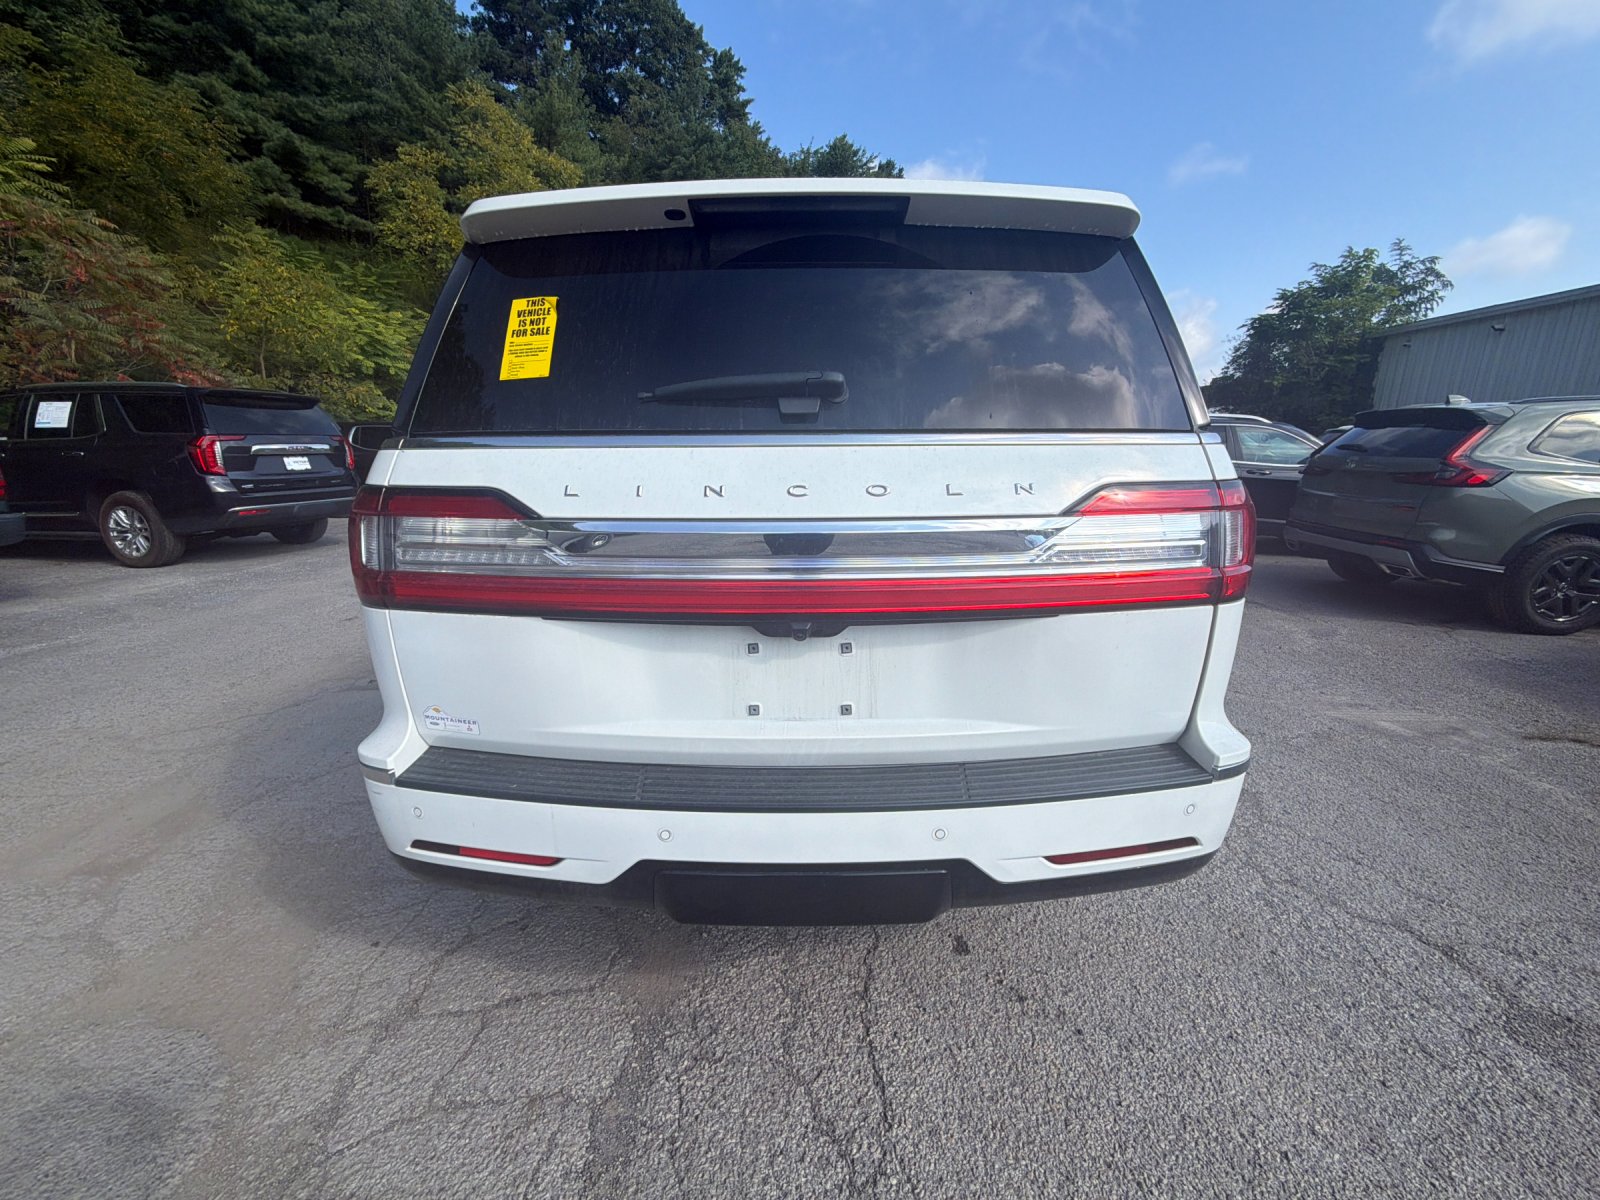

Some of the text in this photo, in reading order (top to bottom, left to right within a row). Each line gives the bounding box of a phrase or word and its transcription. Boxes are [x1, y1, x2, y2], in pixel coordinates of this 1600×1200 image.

[526, 298, 545, 308] THIS
[517, 308, 551, 318] VEHICLE
[518, 317, 547, 328] IS NOT
[511, 326, 551, 338] FOR SALE
[563, 482, 1036, 498] LINCOLN
[424, 715, 476, 725] MOUNTAINEER
